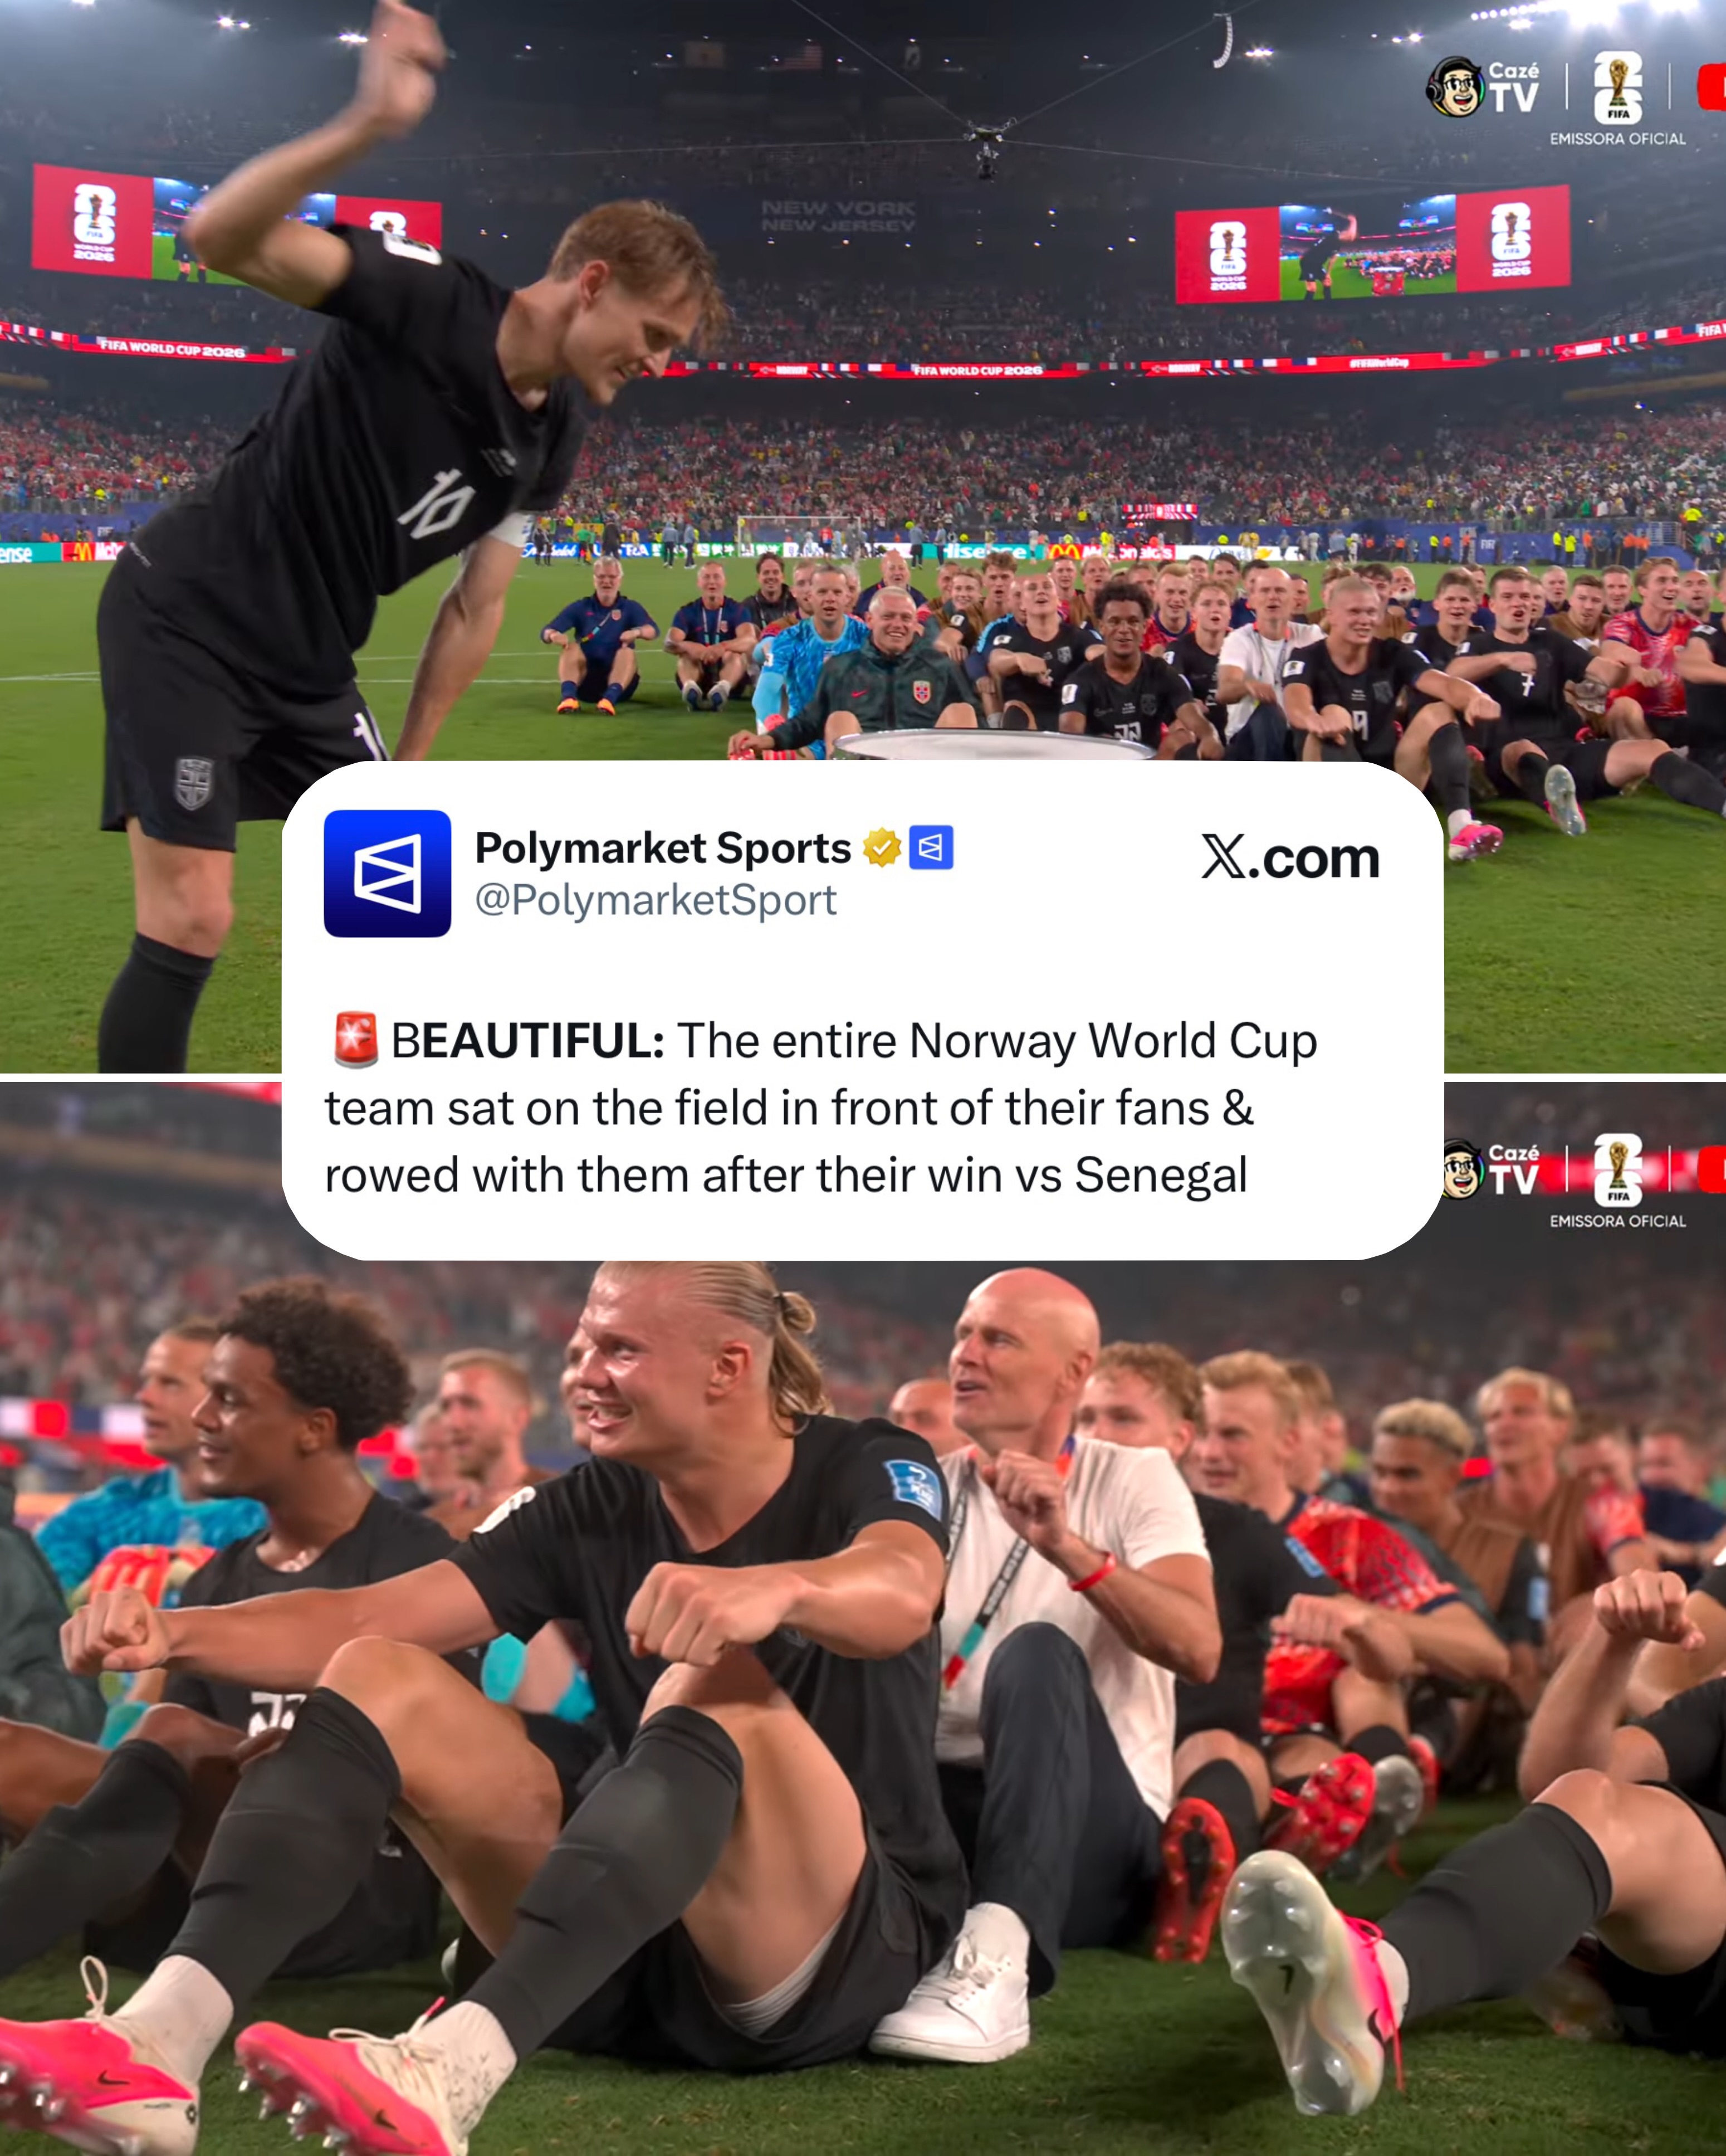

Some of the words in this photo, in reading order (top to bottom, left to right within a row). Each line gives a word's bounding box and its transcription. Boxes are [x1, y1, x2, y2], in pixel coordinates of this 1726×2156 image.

[761, 201, 828, 216] NEW
[835, 201, 916, 216] YORK
[762, 219, 816, 231] NEW
[822, 219, 916, 232] JERSEY
[73, 250, 115, 262] 2026
[1492, 266, 1532, 277] 2026
[1210, 281, 1247, 291] 2026
[1698, 325, 1722, 338] FIFA
[100, 340, 129, 351] FIFA
[129, 342, 175, 354] WORLD
[176, 345, 201, 355] CUP
[202, 347, 247, 358] 2026
[914, 366, 938, 375] FIFA
[939, 366, 980, 375] WORLD
[980, 366, 1003, 375] CUP
[1003, 365, 1044, 376] 2026
[397, 468, 476, 540] 10
[1520, 672, 1536, 697] 7
[1352, 710, 1368, 741] 9
